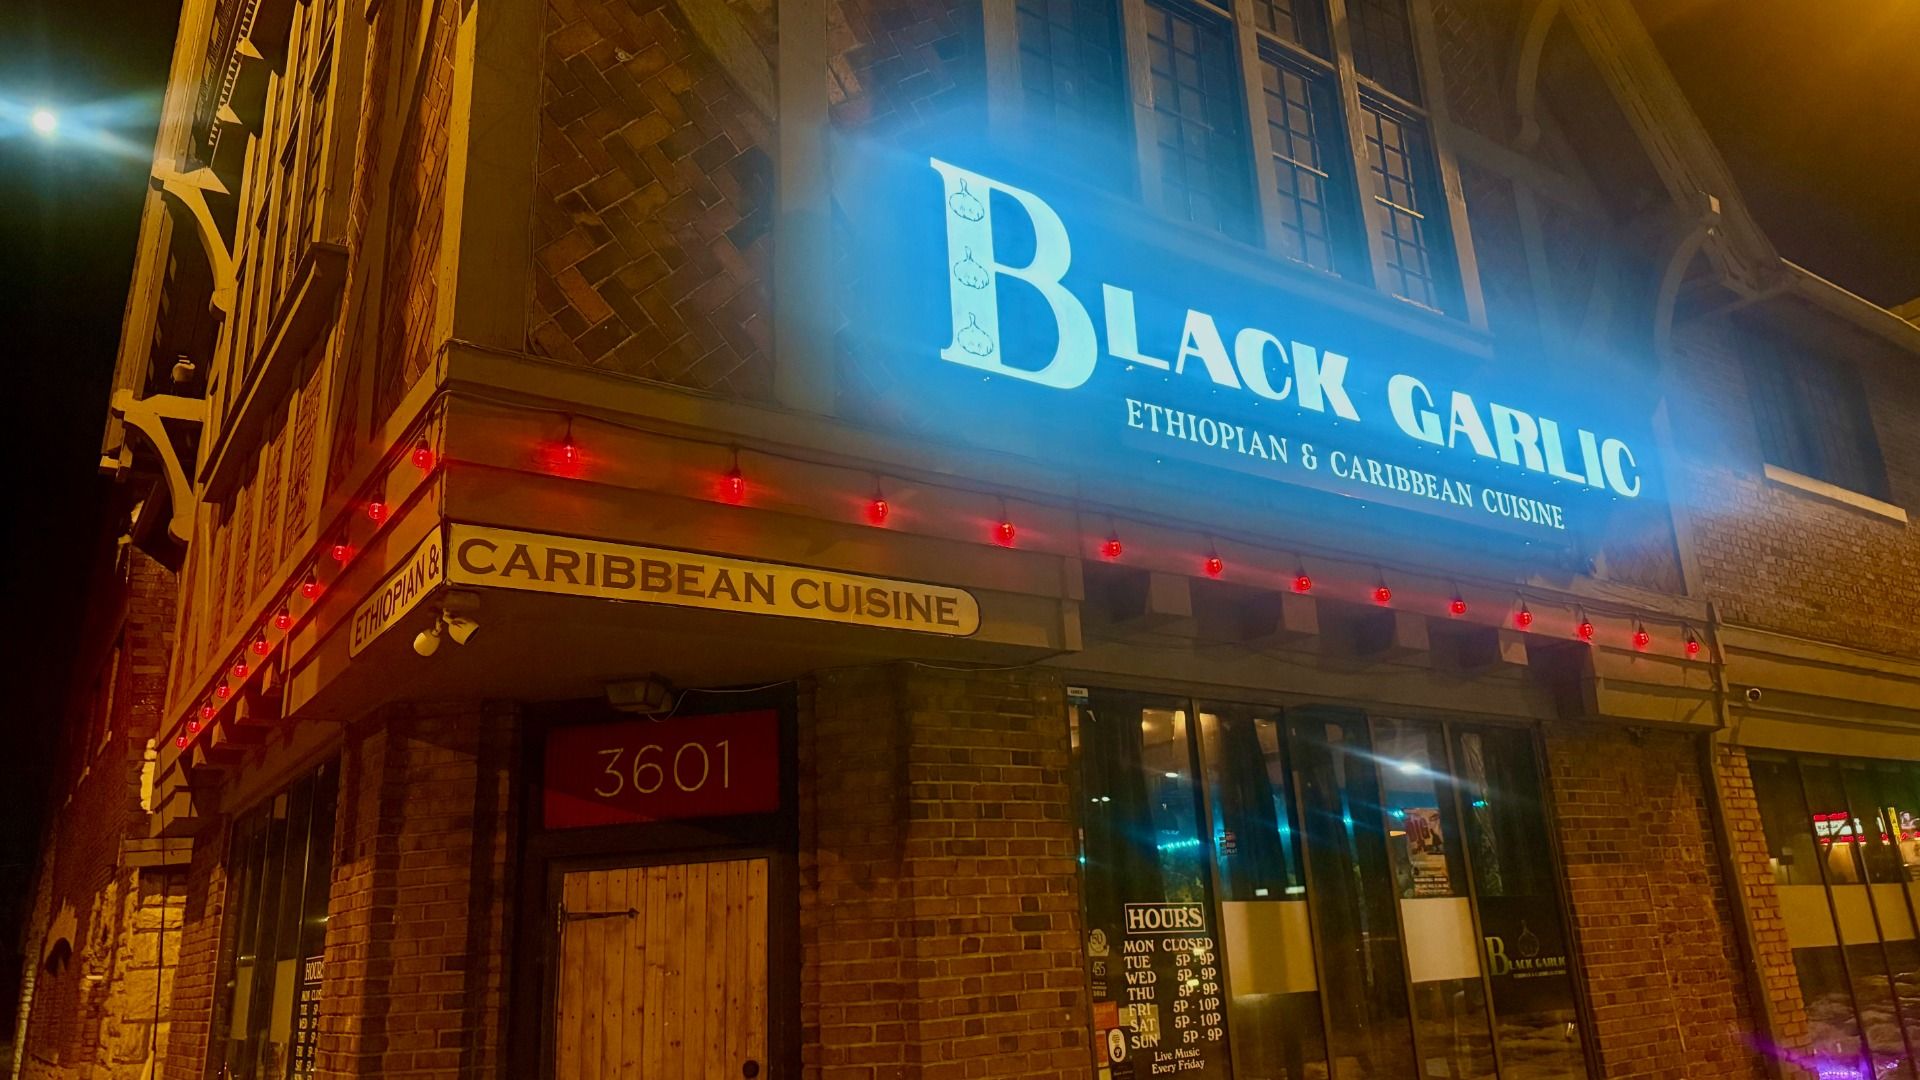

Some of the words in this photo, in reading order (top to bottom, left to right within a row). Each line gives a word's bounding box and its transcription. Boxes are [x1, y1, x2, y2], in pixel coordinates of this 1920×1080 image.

[931, 157, 1360, 422] BLACK
[1387, 374, 1641, 497] GARLIC
[1126, 398, 1288, 463] ETHIOPIAN
[1302, 443, 1317, 470] &
[1330, 451, 1473, 507] CARIBBEAN
[1482, 489, 1565, 529] CUISINE
[354, 554, 426, 647] ETHIOPIAN
[428, 543, 440, 578] &
[457, 538, 776, 606] CARIBBEAN
[790, 578, 960, 628] CUISINE
[594, 739, 729, 797] 3601
[1128, 907, 1203, 929] HOURS
[1123, 939, 1155, 953] MON
[1162, 938, 1213, 951] CLOSED
[1124, 956, 1151, 969] TUE
[1175, 954, 1191, 967] 5P
[1200, 953, 1215, 966] 9P
[1125, 971, 1156, 985] WED
[1177, 969, 1192, 982] 5P
[1201, 968, 1216, 981] 9P
[1127, 987, 1155, 1000] THU
[1178, 985, 1194, 997] 5P
[1203, 983, 1218, 996] 9P
[1128, 1003, 1152, 1017] FRI
[1173, 1000, 1188, 1013] 5P
[1199, 998, 1220, 1011] 10P
[1130, 1018, 1157, 1033] SAT
[1174, 1016, 1190, 1028] 5P
[1200, 1014, 1221, 1027] 10P
[1131, 1035, 1159, 1049] SUN
[1183, 1031, 1198, 1043] 5P
[1208, 1028, 1223, 1041] 9P
[1154, 1051, 1173, 1062] Live
[1175, 1048, 1200, 1060] Music
[1152, 1063, 1176, 1075] Every
[1178, 1060, 1205, 1071] Friday
